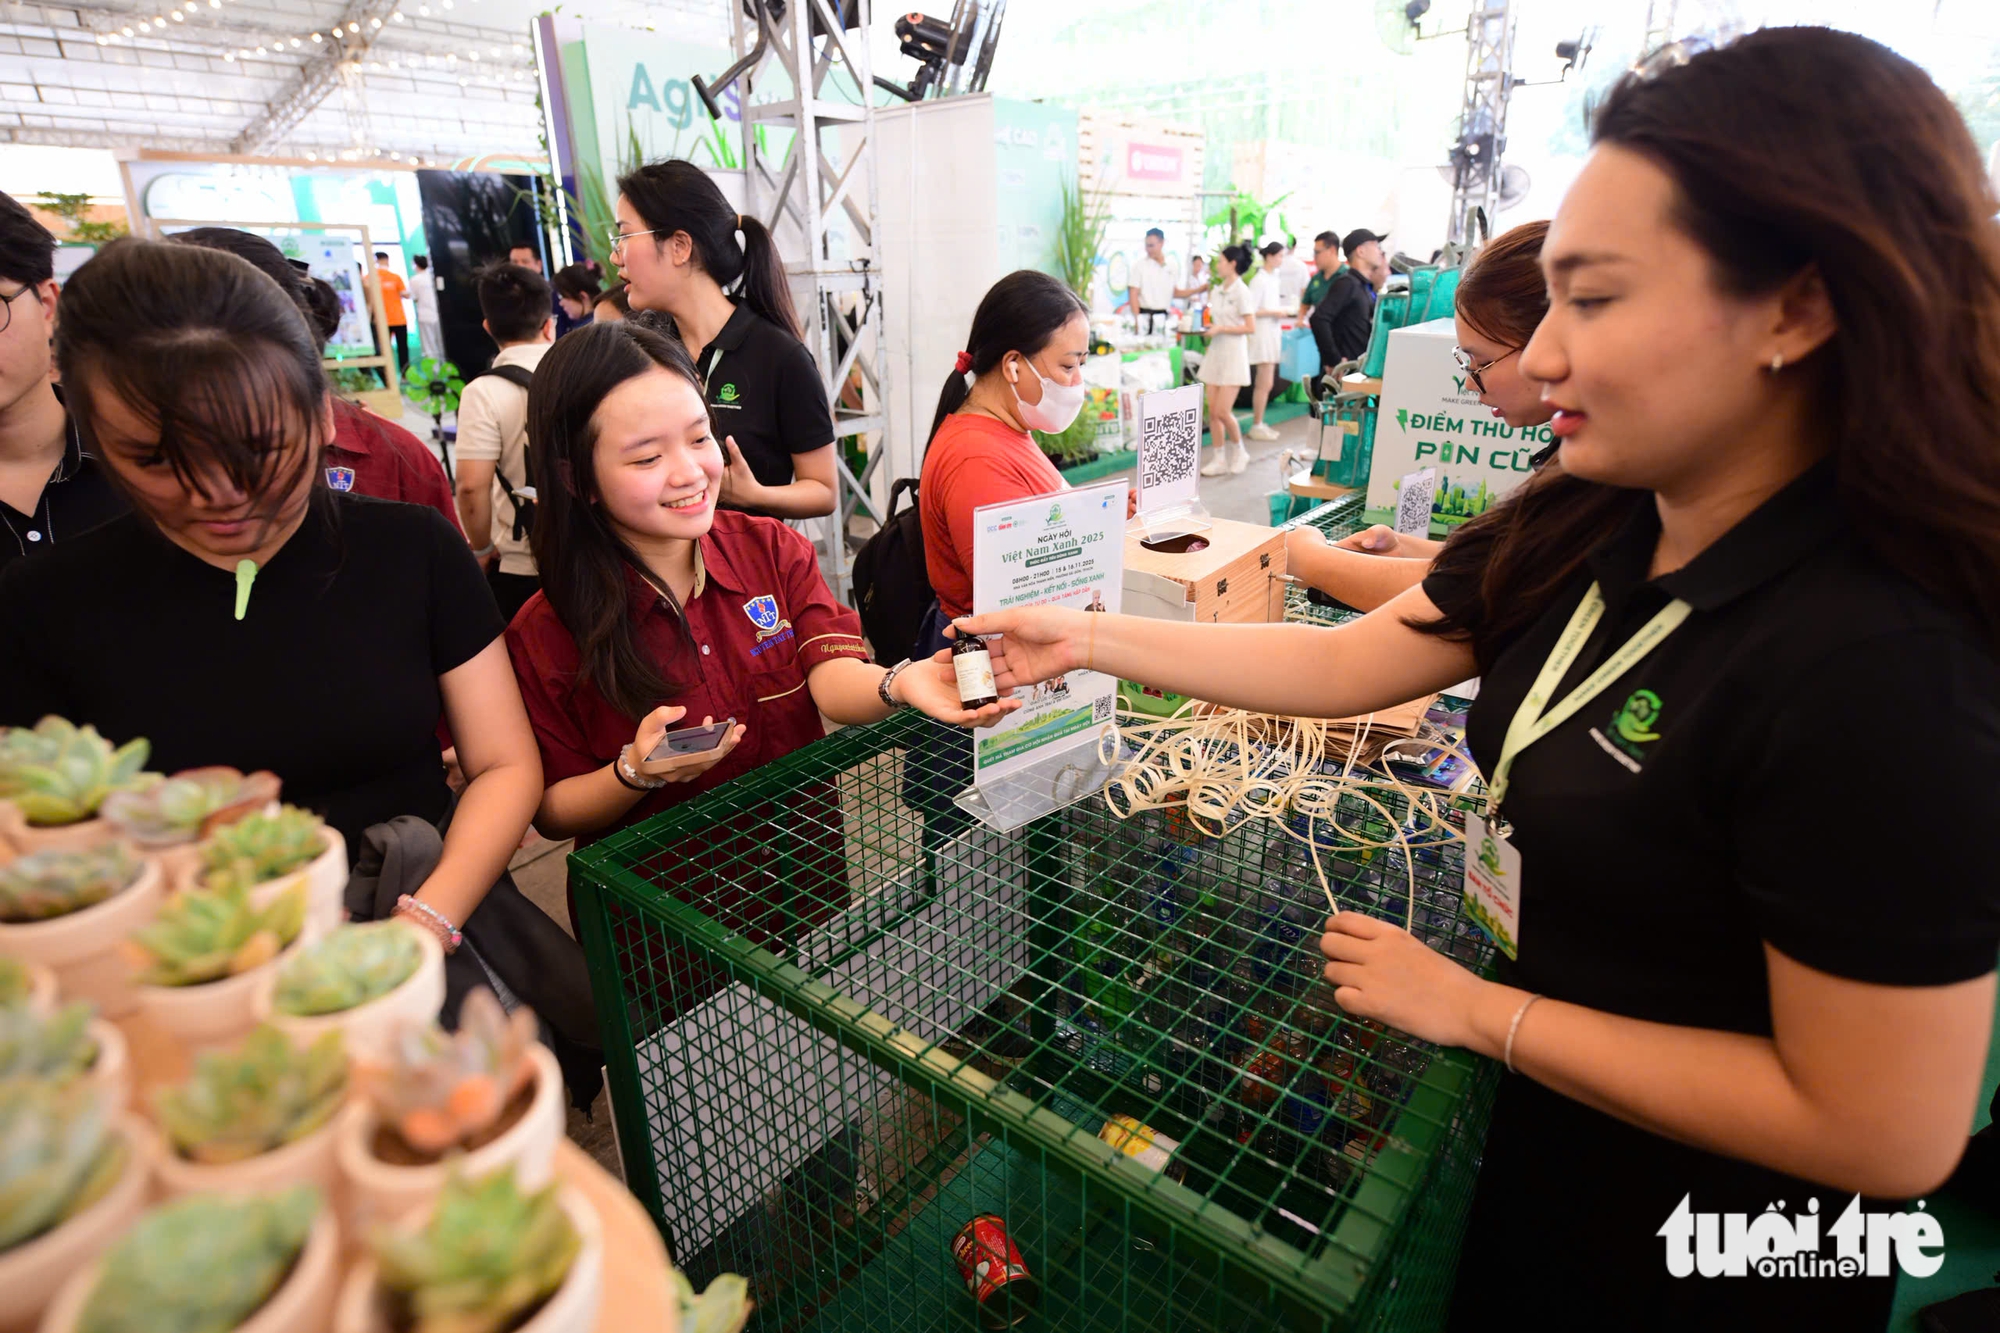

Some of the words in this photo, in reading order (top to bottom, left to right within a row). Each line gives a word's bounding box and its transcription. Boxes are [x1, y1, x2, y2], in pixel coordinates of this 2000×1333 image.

[1410, 410, 1464, 433] ĐIỂM
[1470, 419, 1514, 439] THU
[1415, 440, 1480, 465] PIN
[1489, 448, 1533, 473] CŨ
[1002, 550, 1022, 564] Việt
[1026, 545, 1049, 558] Nam
[1052, 537, 1078, 550] Xanh
[1081, 531, 1104, 545] 2025
[1037, 532, 1058, 544] NGÀY
[1059, 529, 1072, 539] HỘI
[1012, 575, 1030, 584] 08H00
[1033, 570, 1050, 579] 21H00
[1068, 559, 1094, 570] 16.11.2025
[1015, 589, 1040, 601] NGHIỆM
[1044, 584, 1056, 594] KẾT
[1056, 581, 1067, 591] NỐI
[1071, 577, 1088, 587] SỐNG
[1088, 572, 1105, 582] XANH
[756, 610, 776, 626] NTT
